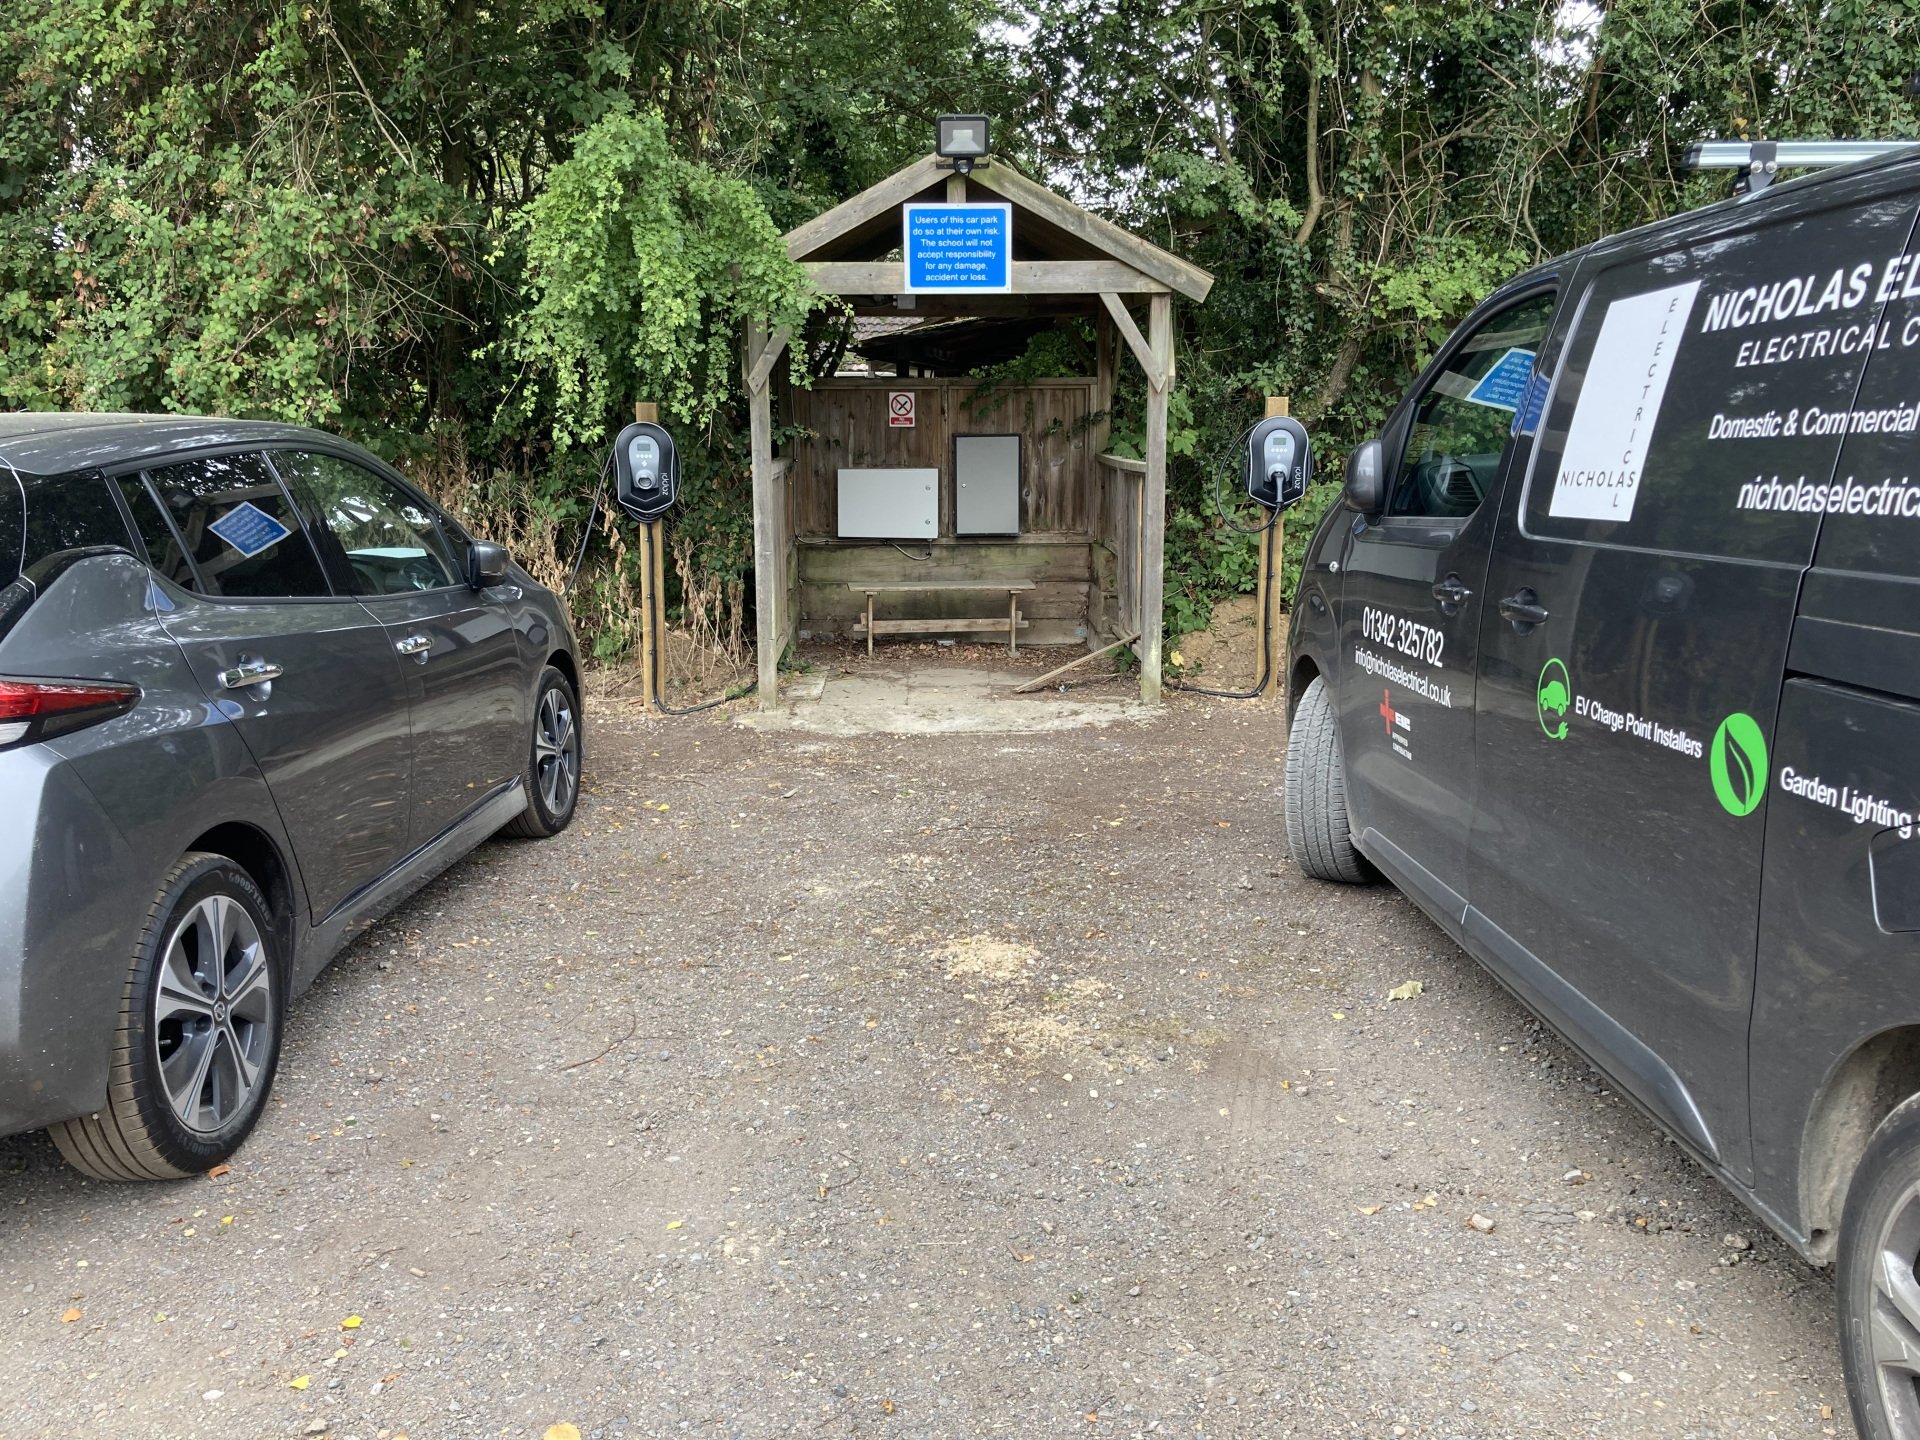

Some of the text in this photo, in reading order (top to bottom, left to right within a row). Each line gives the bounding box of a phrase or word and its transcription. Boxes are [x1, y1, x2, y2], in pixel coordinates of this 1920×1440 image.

[915, 216, 938, 224] Users
[940, 216, 948, 224] of
[950, 216, 964, 224] this
[981, 216, 998, 226] park
[917, 251, 996, 260] accept responsibility
[921, 239, 993, 247] The school will not
[925, 262, 936, 270] for
[938, 263, 952, 272] any
[925, 273, 959, 281] accident
[970, 273, 988, 281] loss.
[1701, 263, 1873, 333] NICHOLAS
[1734, 320, 1891, 368] ELECTRICAL
[1707, 401, 1920, 439] Domestic & Commercial
[660, 472, 670, 496] zappi
[1294, 466, 1302, 489] zappi
[1560, 471, 1636, 488] NICHOLAS
[1736, 475, 1920, 517] nicholaselectric
[1362, 606, 1444, 668] 01342 325782
[1355, 645, 1451, 708] info@nicholaselectrical.co.uk
[1575, 695, 1702, 758] EV Charge Point Installers
[1781, 766, 1838, 807] Garden
[1841, 786, 1912, 839] Lighting
